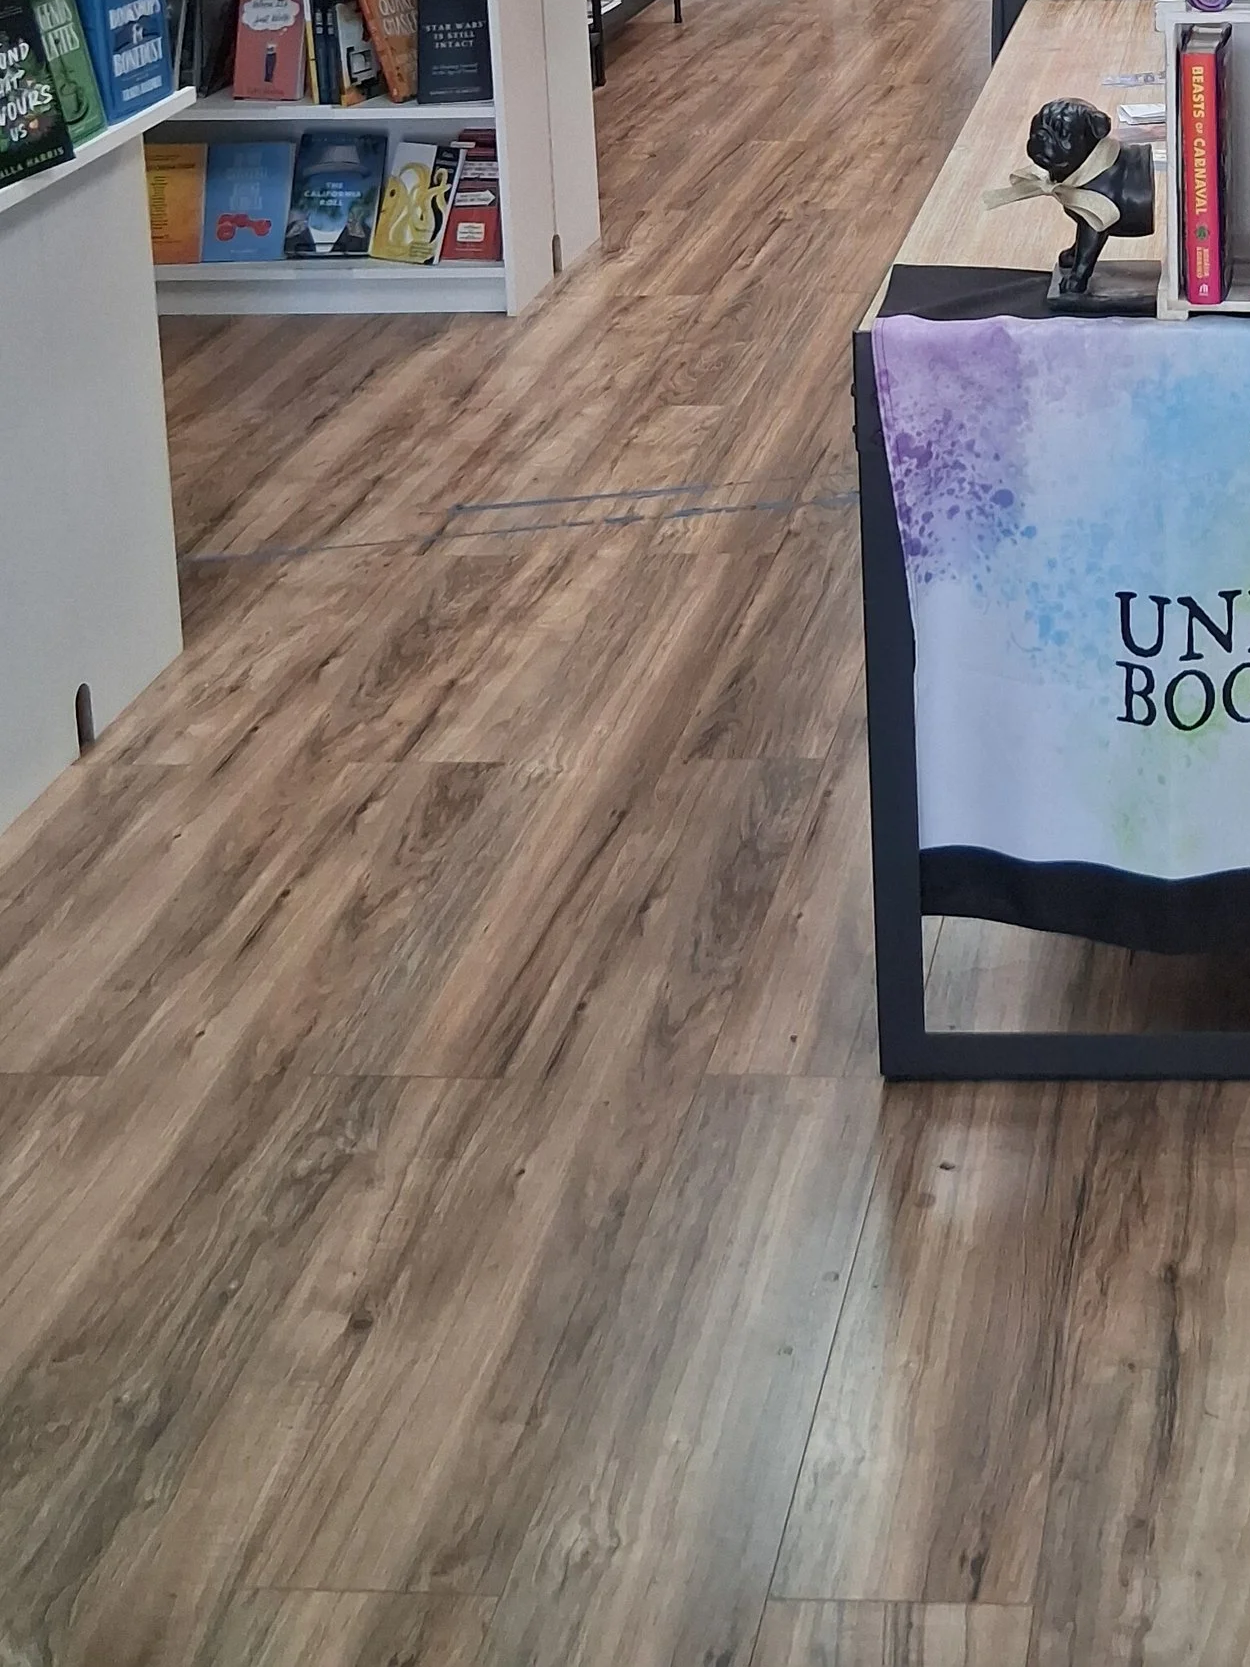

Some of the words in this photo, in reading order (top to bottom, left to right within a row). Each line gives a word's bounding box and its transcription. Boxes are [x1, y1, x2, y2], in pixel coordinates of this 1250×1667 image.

[435, 40, 474, 48] INTACT
[1191, 65, 1205, 119] BEASTS
[10, 123, 28, 142] US
[1193, 137, 1209, 215] CARNAVAL
[304, 190, 361, 198] CALIFORNIA
[320, 198, 342, 206] ROLL
